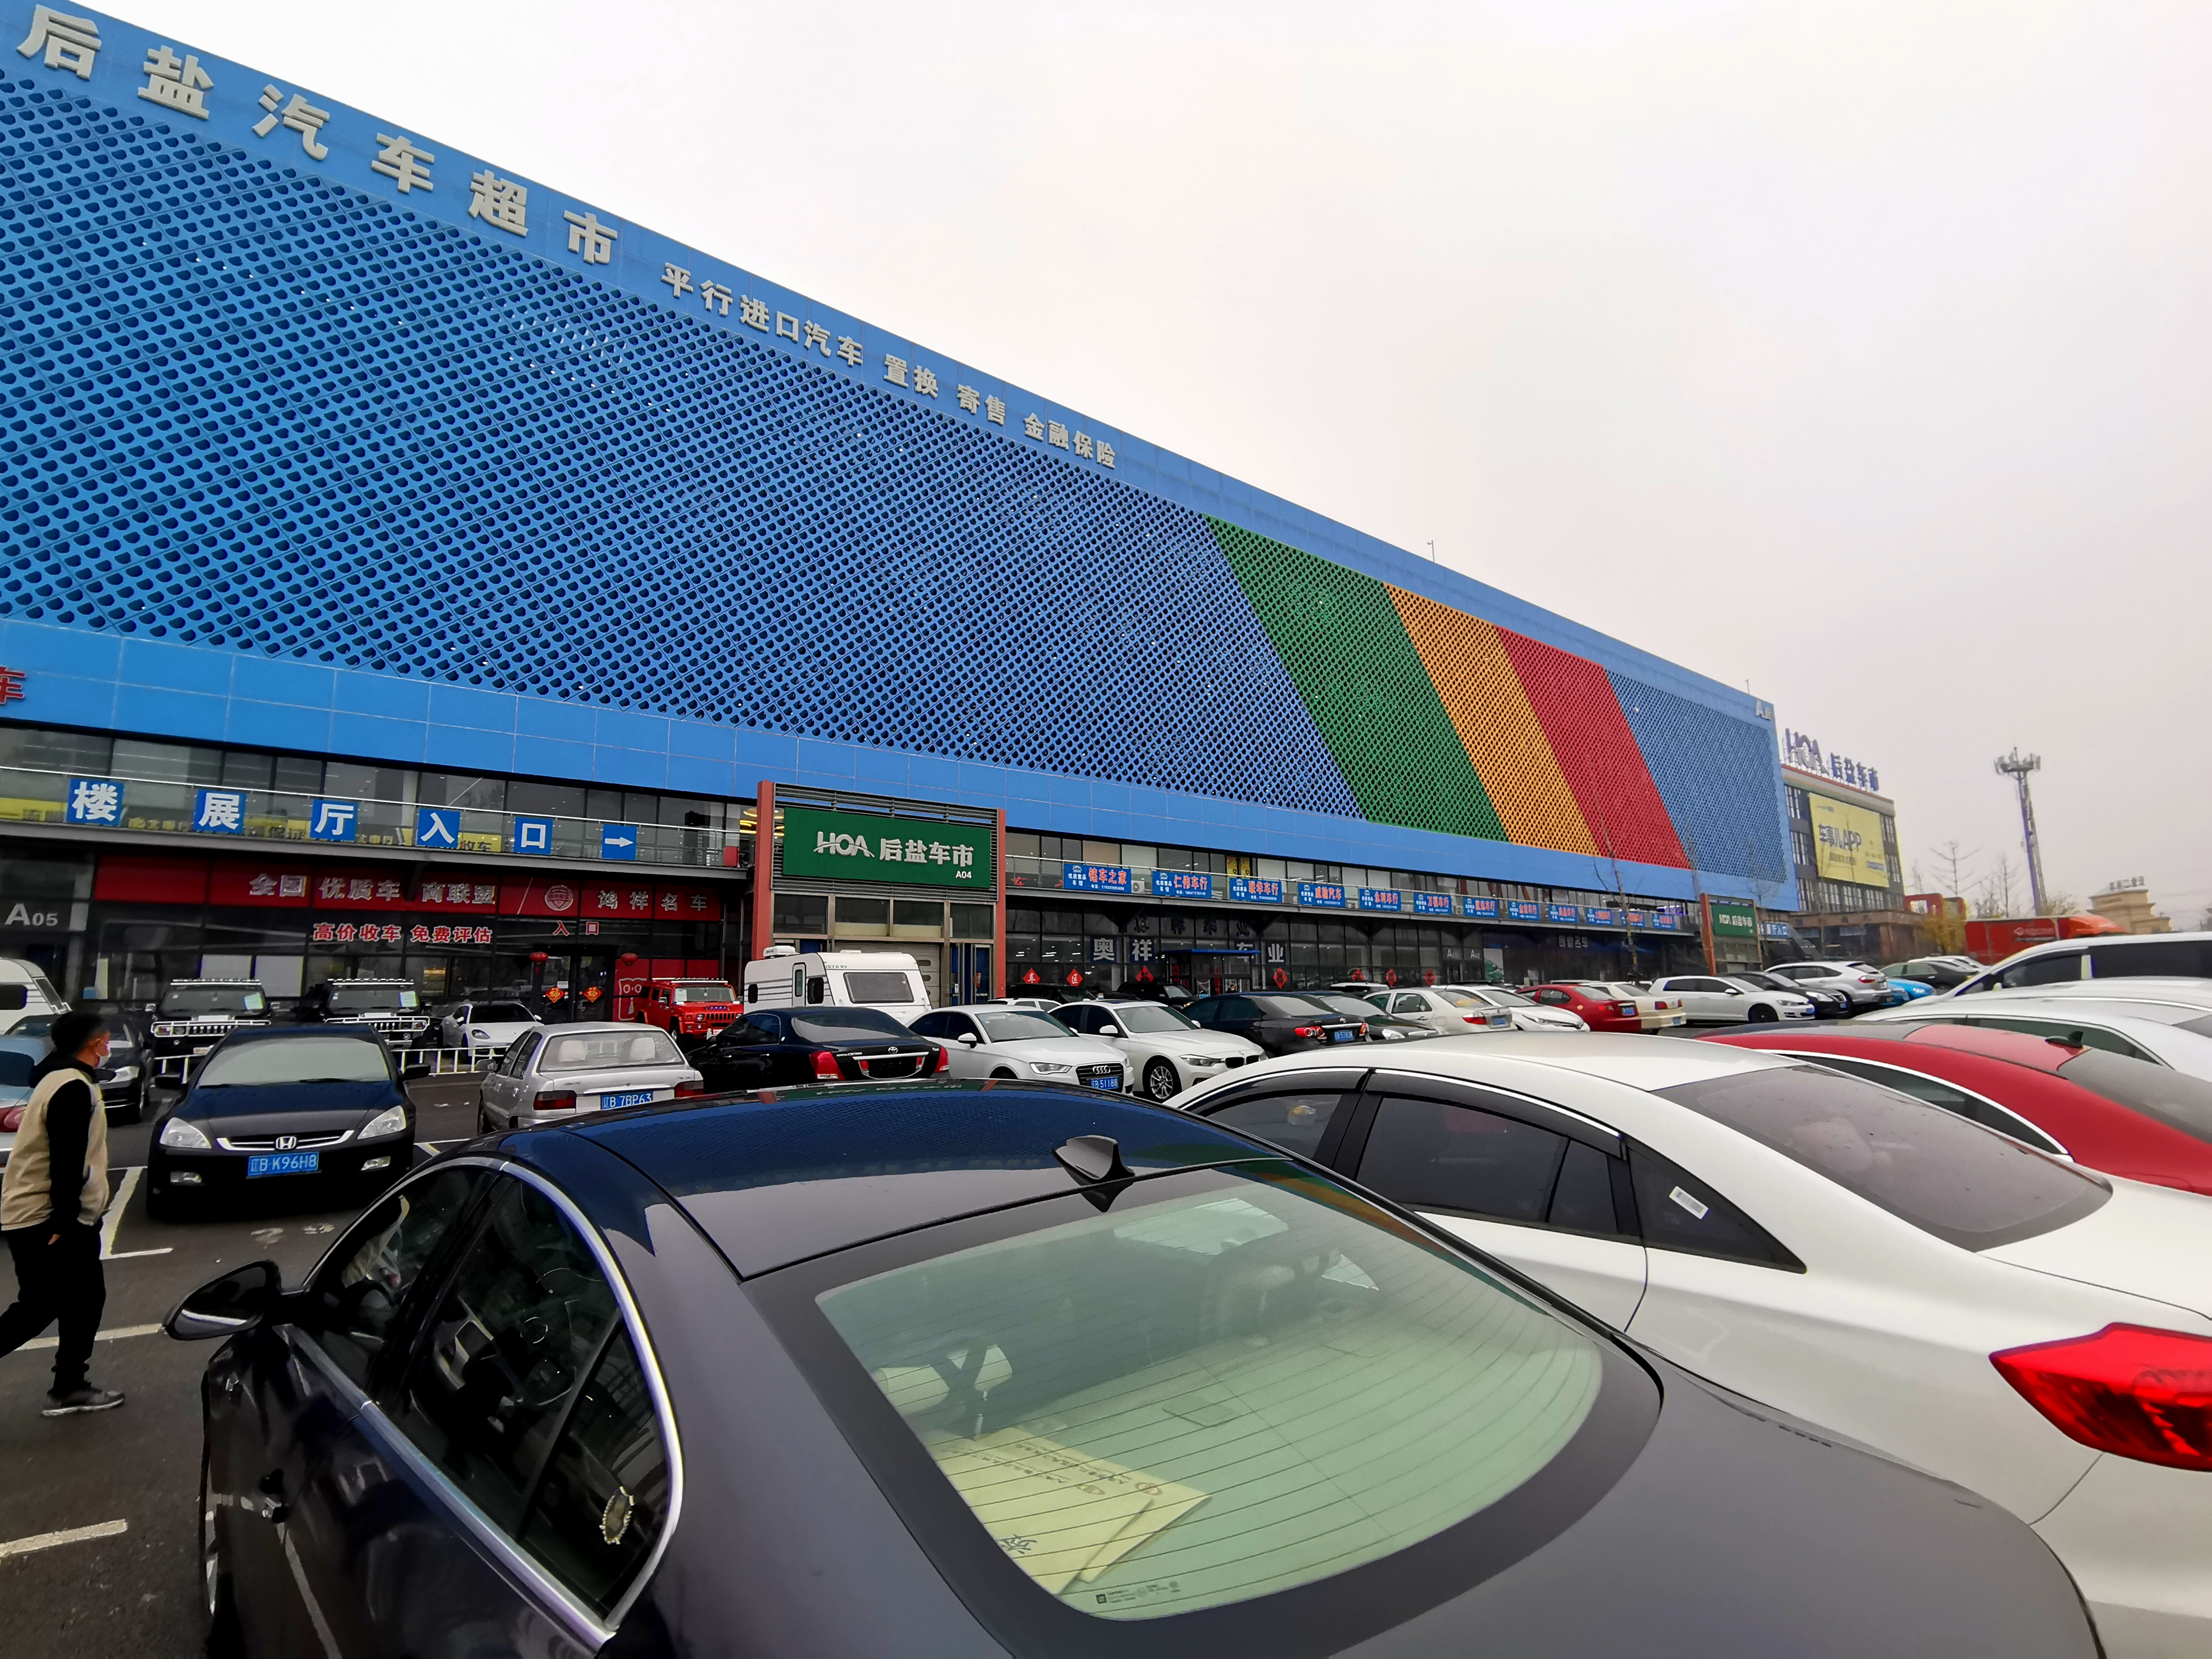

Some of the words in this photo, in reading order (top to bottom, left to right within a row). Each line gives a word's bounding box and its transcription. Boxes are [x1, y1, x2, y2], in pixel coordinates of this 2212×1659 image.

[17, 4, 618, 266] 后盐汽车超市
[661, 262, 863, 367] 平行进口汽车
[884, 354, 938, 398] 置换
[958, 384, 1006, 426] 寄售
[1023, 412, 1116, 470] 金融保险
[813, 831, 875, 858] HOA
[879, 838, 975, 867] 后盐车市
[955, 870, 972, 879] A04
[597, 890, 708, 912] 鸿祥名车
[4, 903, 59, 926] A05
[313, 922, 402, 943] 高价收车
[410, 925, 493, 944] 免费评估
[553, 920, 600, 937] 入口
